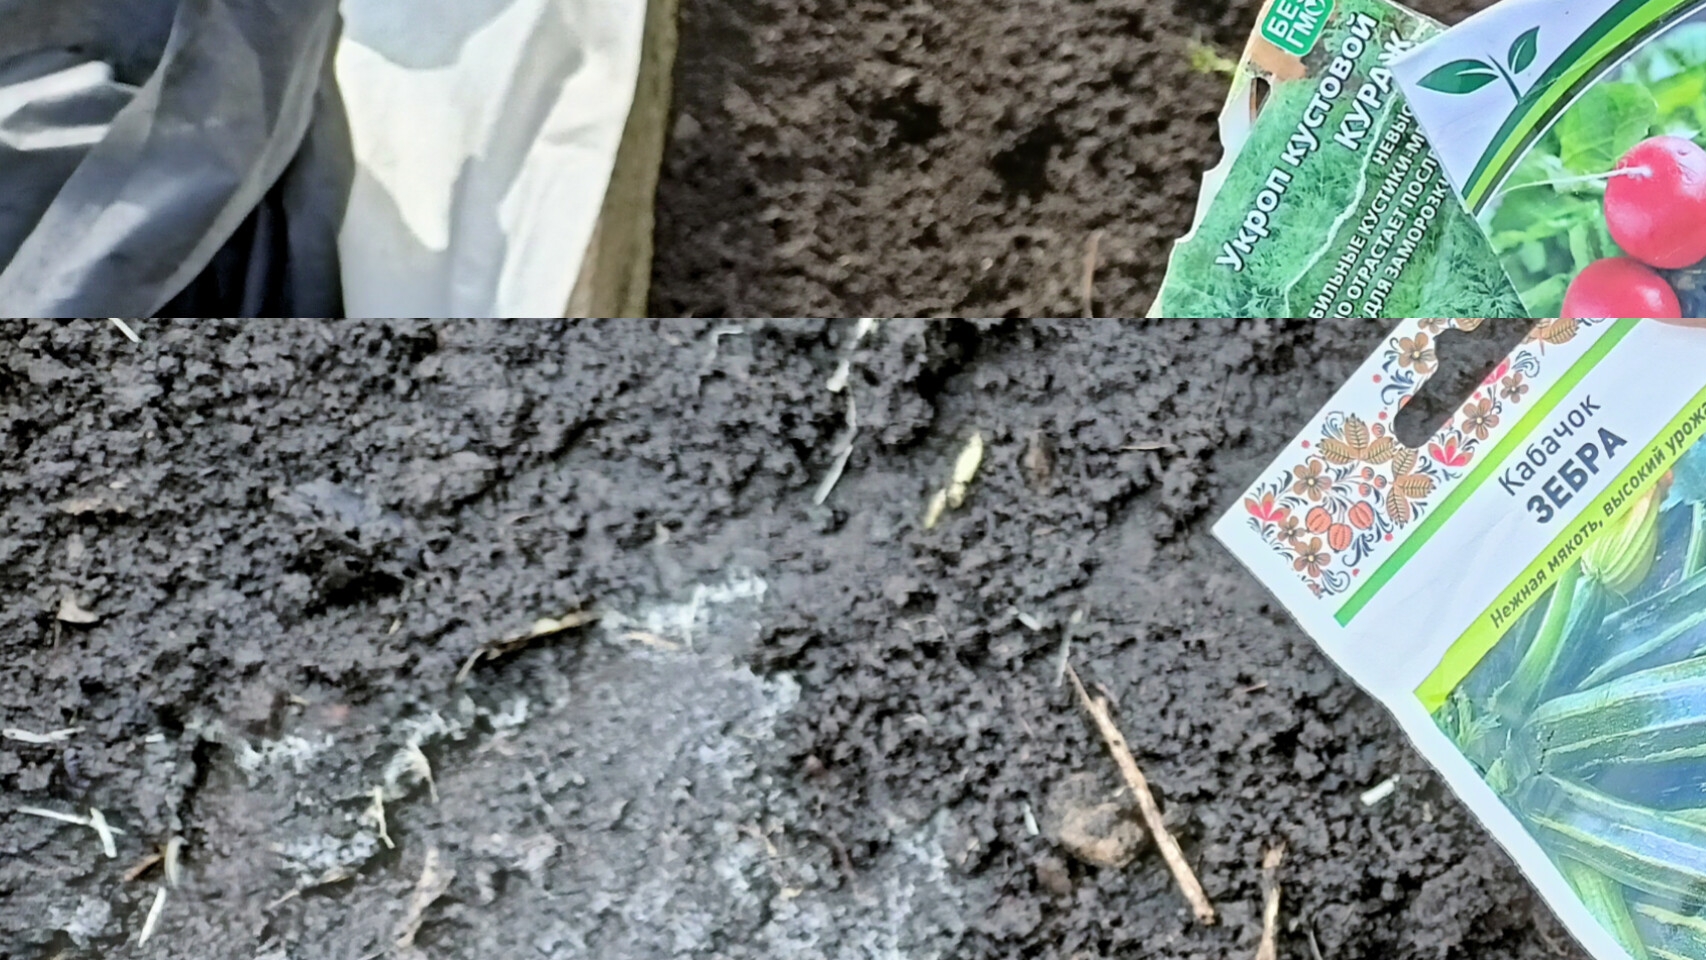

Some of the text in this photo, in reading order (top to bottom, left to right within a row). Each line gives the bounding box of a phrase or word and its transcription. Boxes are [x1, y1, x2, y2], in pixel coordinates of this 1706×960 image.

[1215, 13, 1378, 271] Укроп кустовой
[1347, 207, 1408, 299] ОТРАСТАЕТ
[1498, 395, 1601, 496] Кабачок
[1527, 427, 1628, 524] ЗЕБРА
[1490, 570, 1546, 628] Нежная
[1547, 520, 1603, 571] мякоть,
[1603, 446, 1666, 517] высокий
